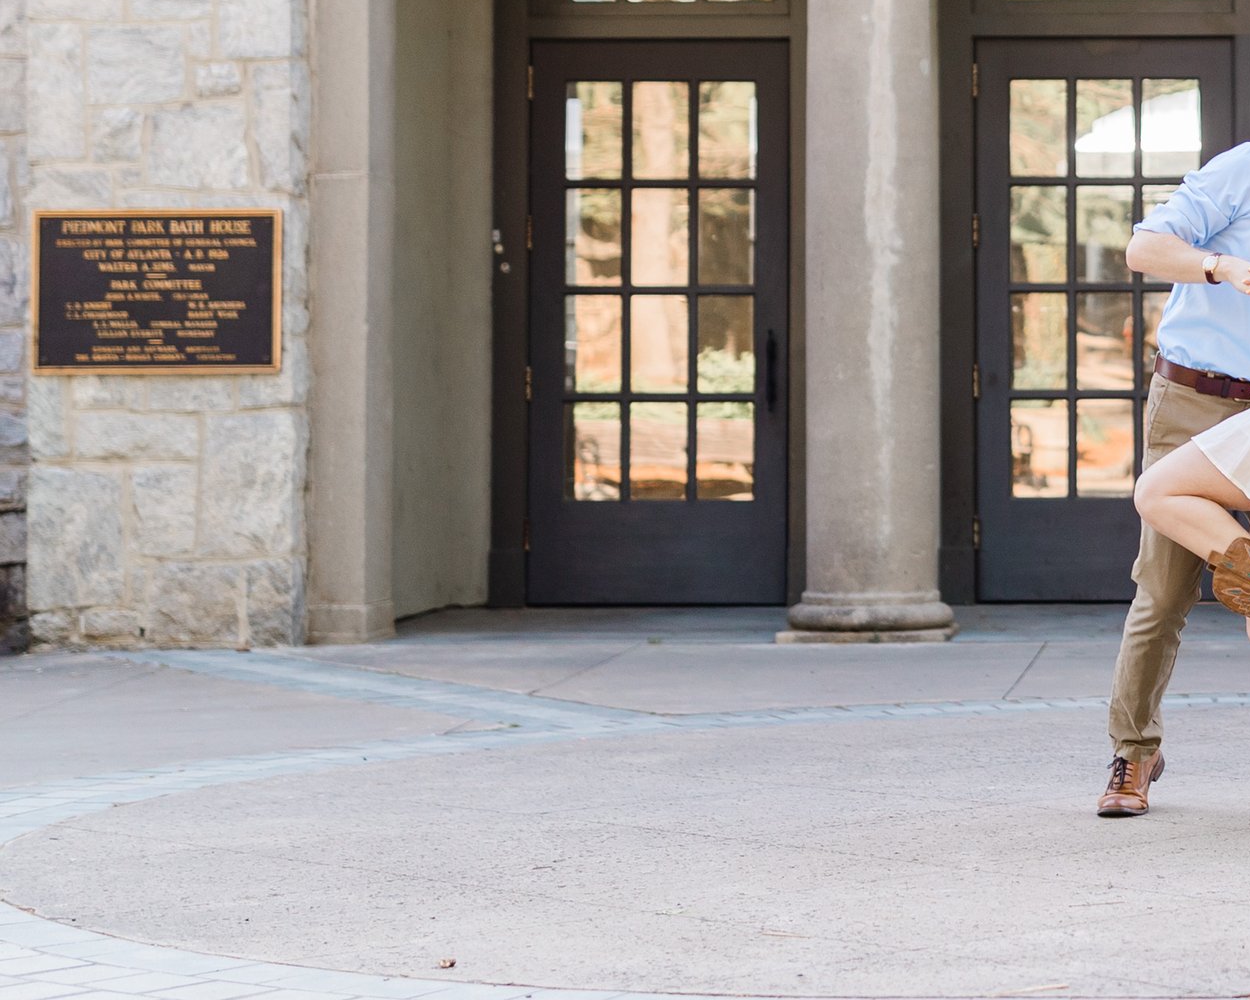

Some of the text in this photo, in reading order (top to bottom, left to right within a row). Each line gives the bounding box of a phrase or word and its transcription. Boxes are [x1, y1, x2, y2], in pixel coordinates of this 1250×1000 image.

[62, 220, 251, 234] PIEDMONT PARK BATH HOUSE
[83, 250, 106, 260] CITY
[127, 249, 172, 260] ATLANTA
[98, 262, 138, 272] WALTER
[111, 280, 202, 290] PARK COMMITTEE
